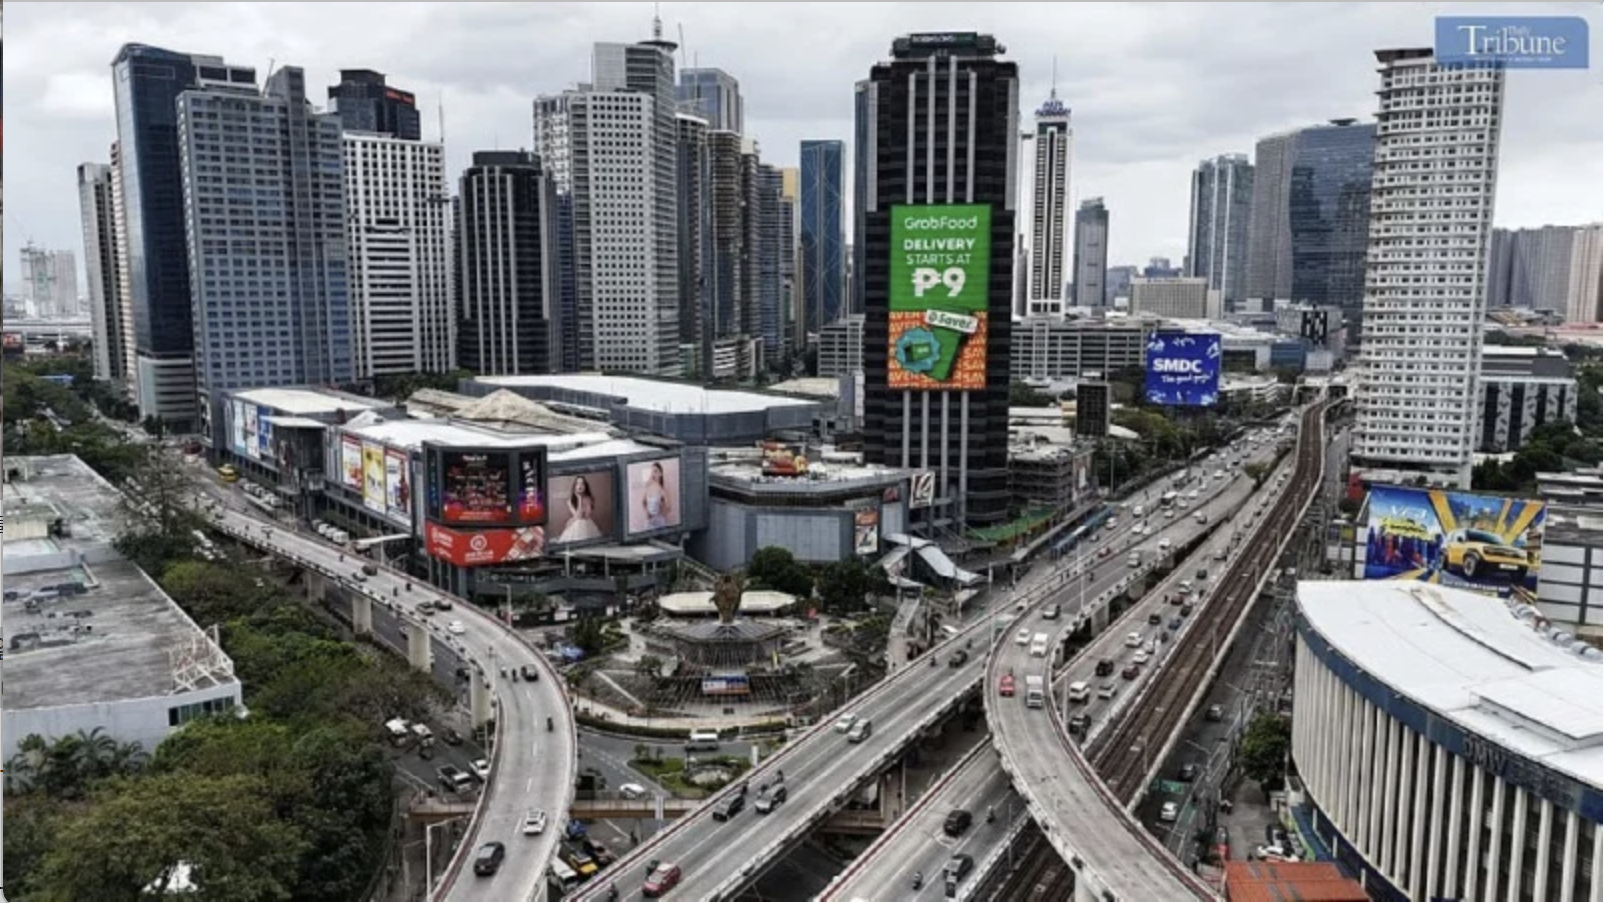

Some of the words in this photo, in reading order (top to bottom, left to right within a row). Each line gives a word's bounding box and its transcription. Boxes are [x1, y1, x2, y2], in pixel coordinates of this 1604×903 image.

[904, 216, 978, 230] GrabFood
[904, 238, 975, 250] DELIVERY
[906, 253, 953, 265] STARTS
[956, 253, 972, 265] AT
[939, 313, 973, 329] Saver
[1152, 358, 1203, 373] SMDC
